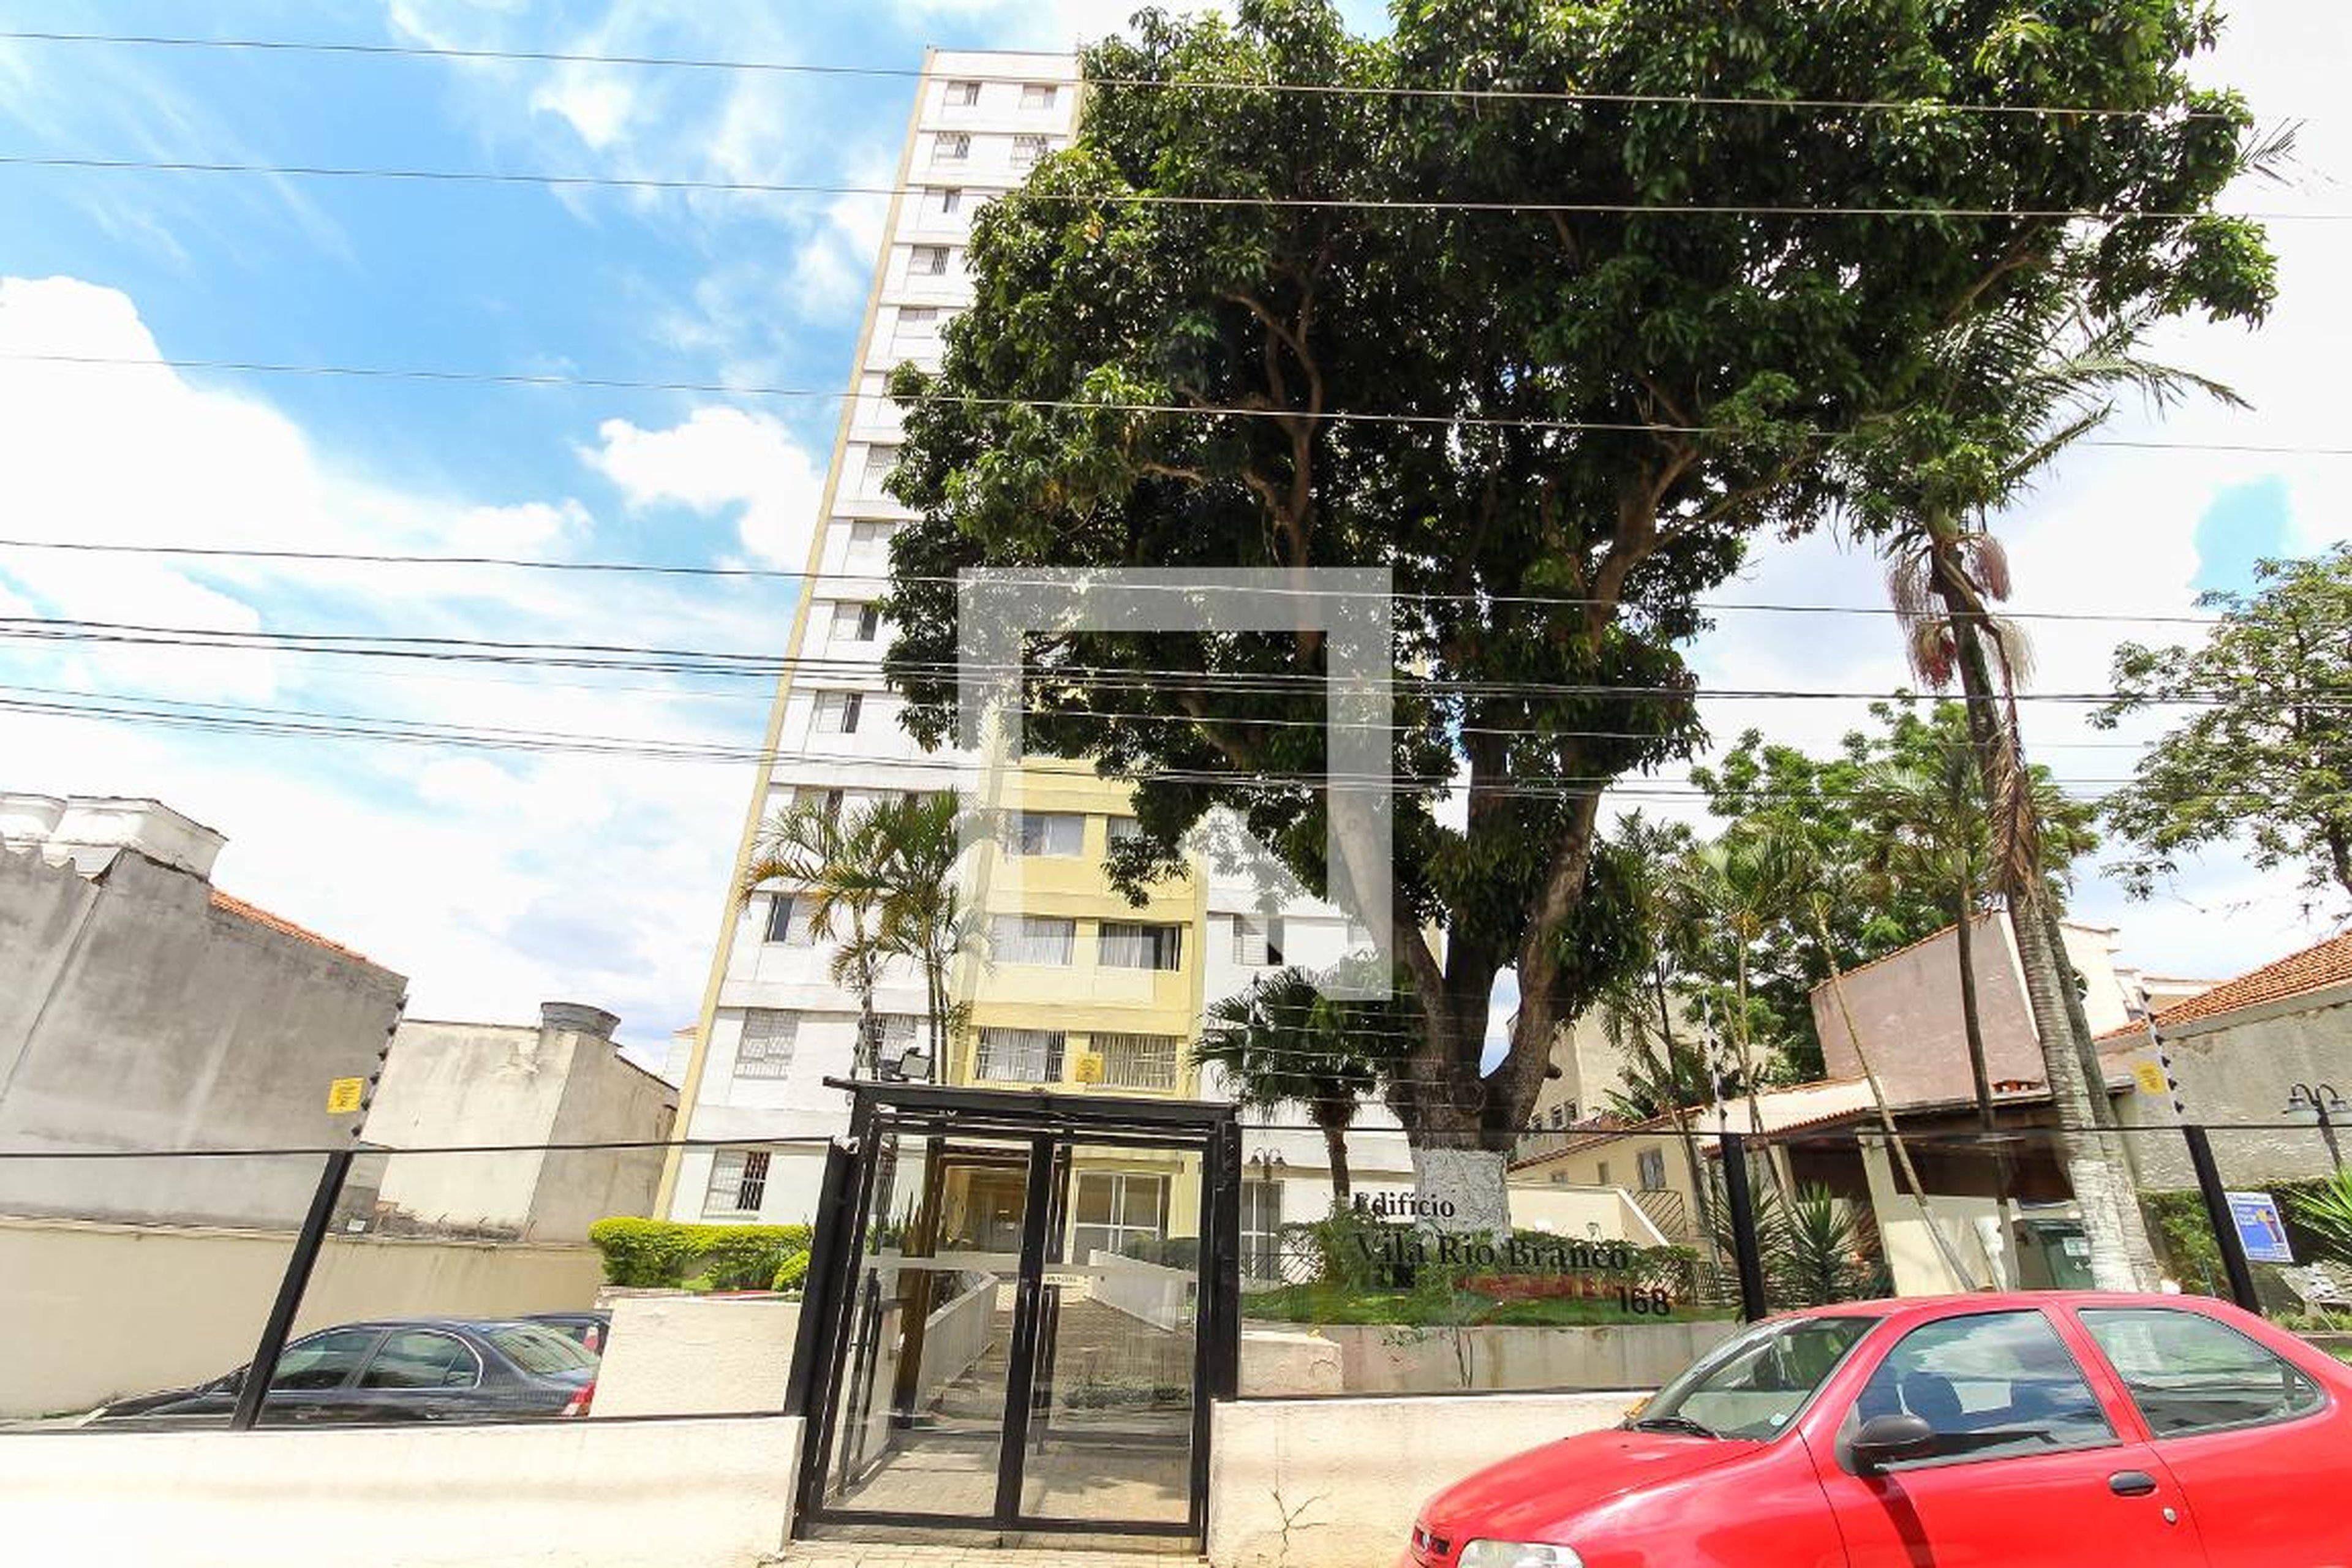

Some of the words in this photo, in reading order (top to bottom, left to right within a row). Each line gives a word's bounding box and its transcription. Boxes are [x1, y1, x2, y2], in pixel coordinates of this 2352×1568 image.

[1355, 1233, 1426, 1263] Vila
[1437, 1234, 1495, 1265] Rio
[1508, 1237, 1627, 1269] Branco
[1617, 1286, 1670, 1316] 168
